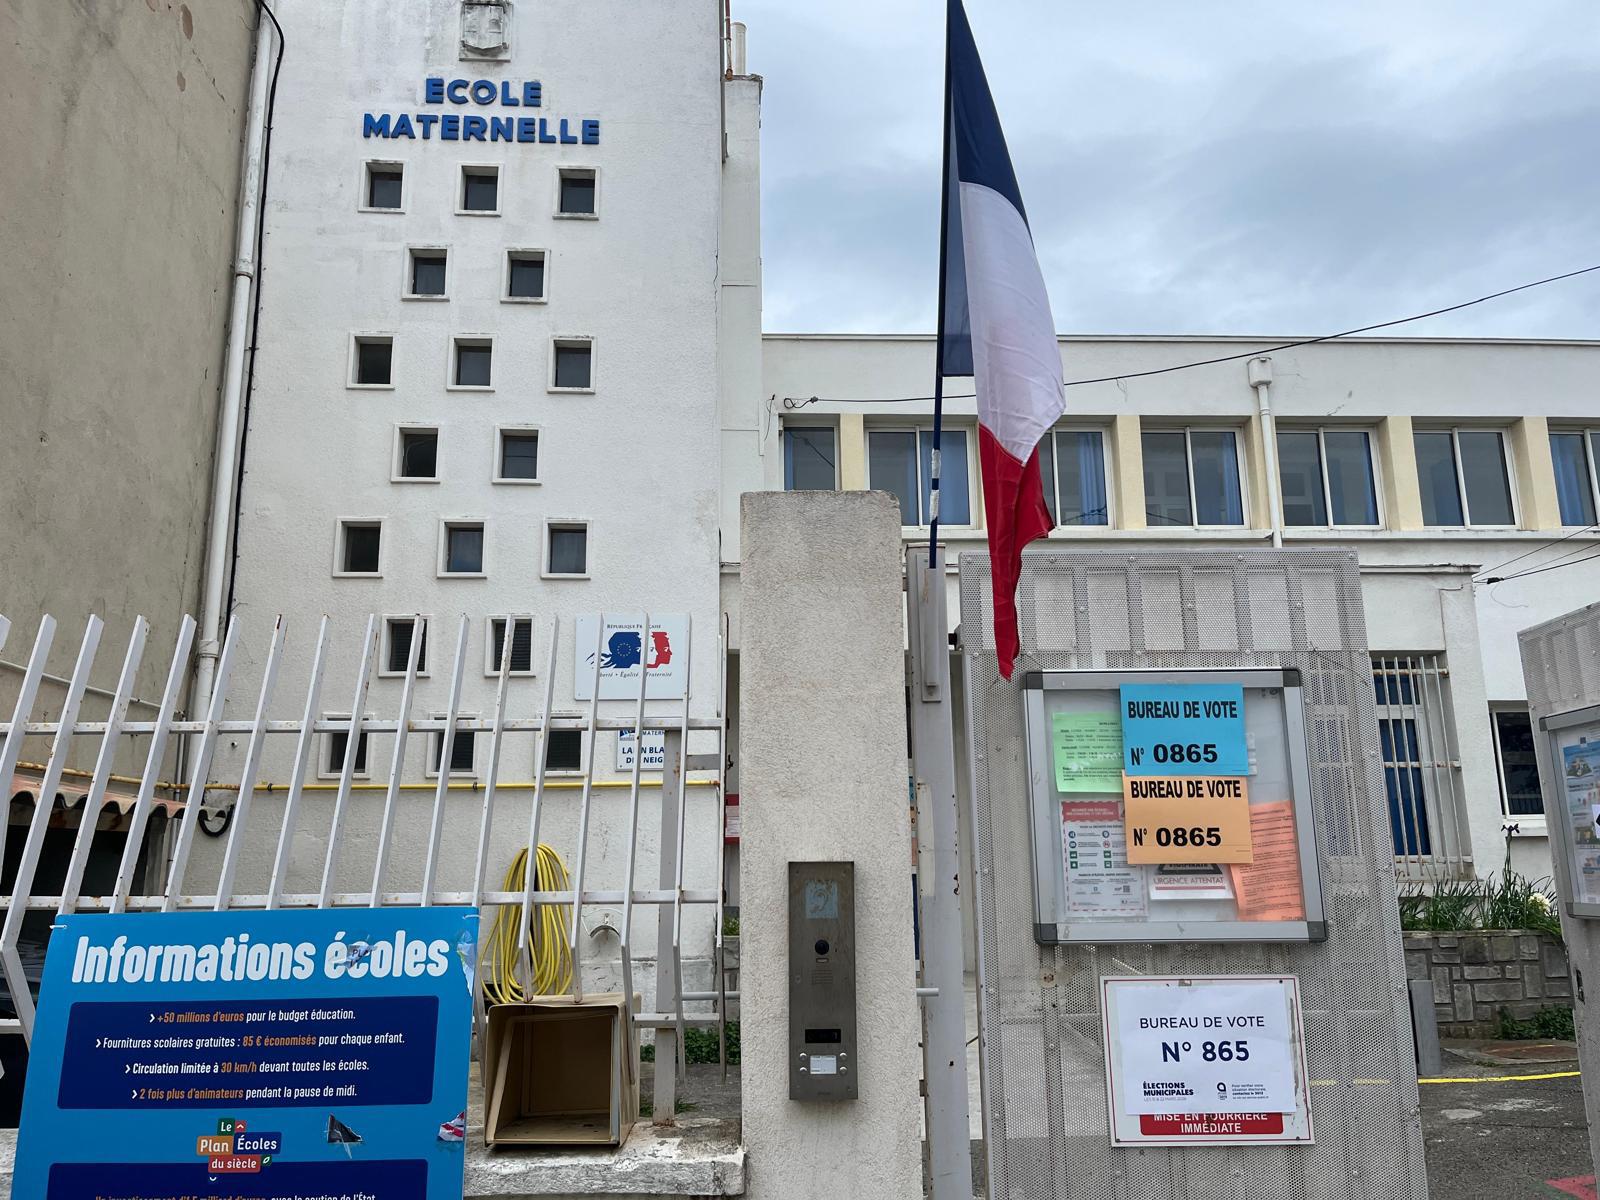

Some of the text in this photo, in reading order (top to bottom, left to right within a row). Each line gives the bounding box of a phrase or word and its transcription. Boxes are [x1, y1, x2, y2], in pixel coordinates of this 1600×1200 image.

[425, 78, 542, 107] ECOLE
[363, 113, 600, 145] MATERNELLE
[1128, 700, 1238, 719] BUREAU DE VOTE
[1130, 743, 1218, 766] N° 0865
[1130, 780, 1242, 799] BUREAU DE VOTE
[1133, 827, 1222, 847] N° 0865
[1153, 876, 1224, 885] URGENCE ATTENTAT
[71, 930, 449, 983] Informations écoles
[158, 1009, 356, 1023] +50 millions d'euros pour le budget éducation.
[1140, 1016, 1265, 1029] BUREAU DE VOTE
[103, 1037, 151, 1049] Fournitures
[153, 1036, 193, 1048] scolaires
[195, 1036, 235, 1050] gratuites
[243, 1036, 254, 1046] 85
[255, 1036, 262, 1046] €
[264, 1035, 317, 1046] économisés
[318, 1036, 338, 1047] pour
[340, 1034, 372, 1046] chaque
[374, 1033, 405, 1044] enfant.
[1162, 1041, 1250, 1062] N° 865
[133, 1059, 369, 1074] Circulation limitée à 30 km/h devant toutes les écoles.
[139, 1084, 357, 1100] 2 fois plus d'animateurs pendant la pause de midi.
[1143, 1081, 1185, 1089] ÉLECTIONS
[1184, 1113, 1199, 1121] EN
[221, 1122, 232, 1132] Le
[1180, 1121, 1242, 1133] IMMÉDIATE
[200, 1135, 277, 1152] Plan Écoles
[212, 1158, 257, 1169] du siècle
